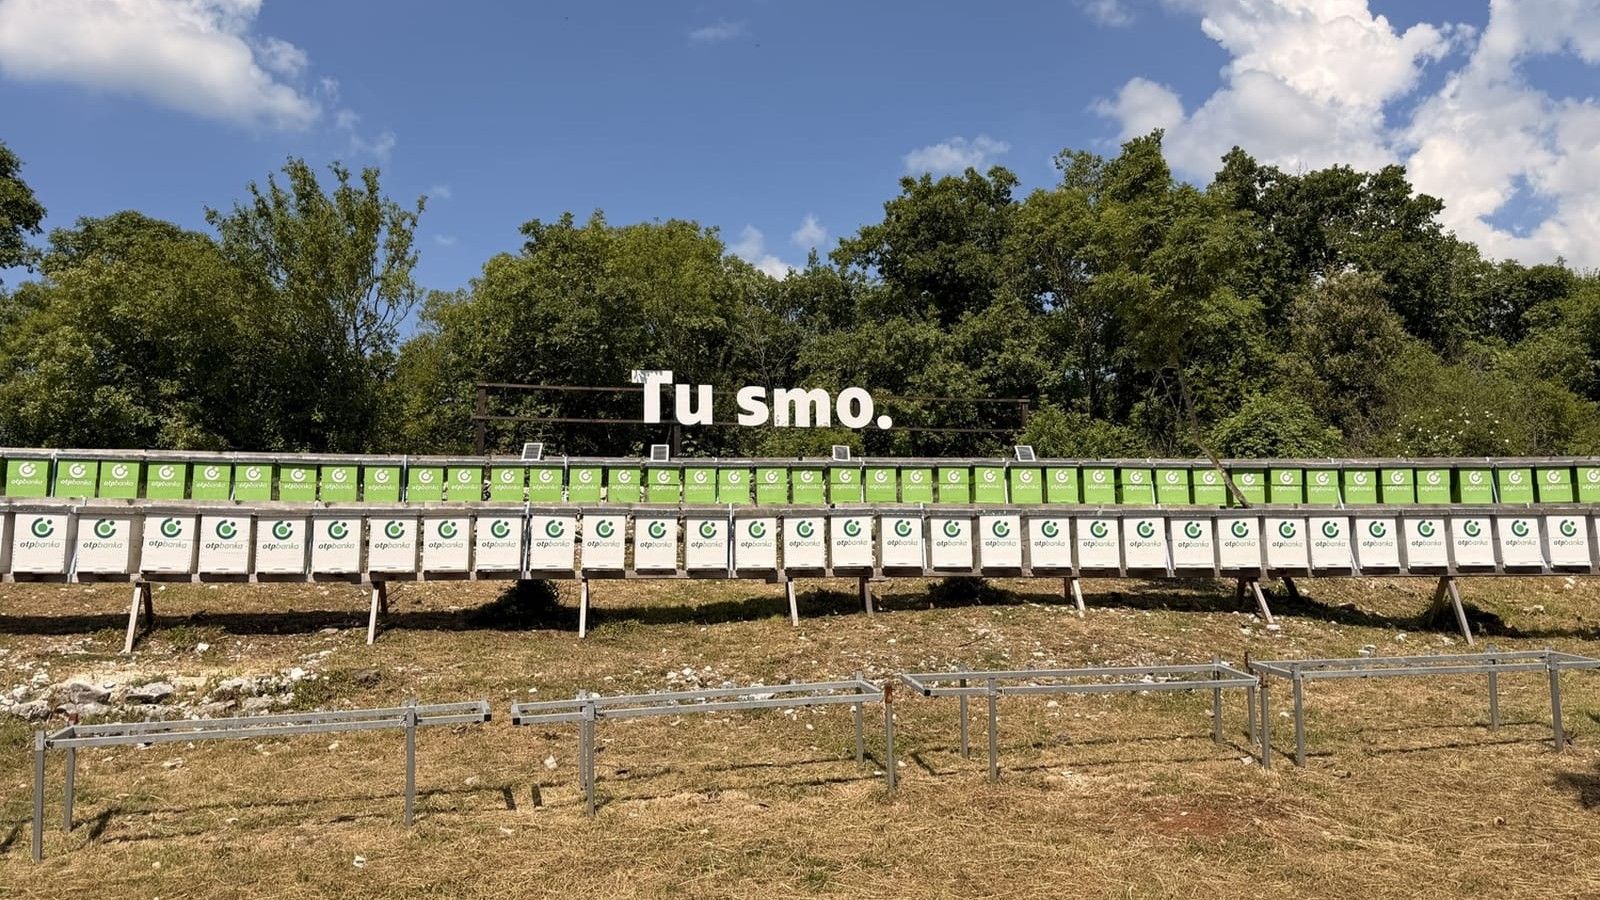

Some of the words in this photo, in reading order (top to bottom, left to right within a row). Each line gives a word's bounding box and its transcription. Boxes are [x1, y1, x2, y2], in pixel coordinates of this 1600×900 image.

[631, 369, 713, 426] Tu
[736, 386, 893, 430] smo.
[20, 541, 60, 549] otpbanka
[83, 541, 122, 549] otpbanka
[149, 540, 187, 549] otpbanka
[205, 541, 243, 550] otpbanka
[262, 542, 299, 550] otpbanka
[318, 541, 355, 550] otpbanka
[374, 541, 410, 550] otpbanka
[429, 541, 463, 549] otpbanka
[482, 540, 516, 549] otpbanka
[536, 540, 570, 549] otpbanka
[587, 540, 620, 548] otpbanka
[640, 540, 672, 548] otpbanka
